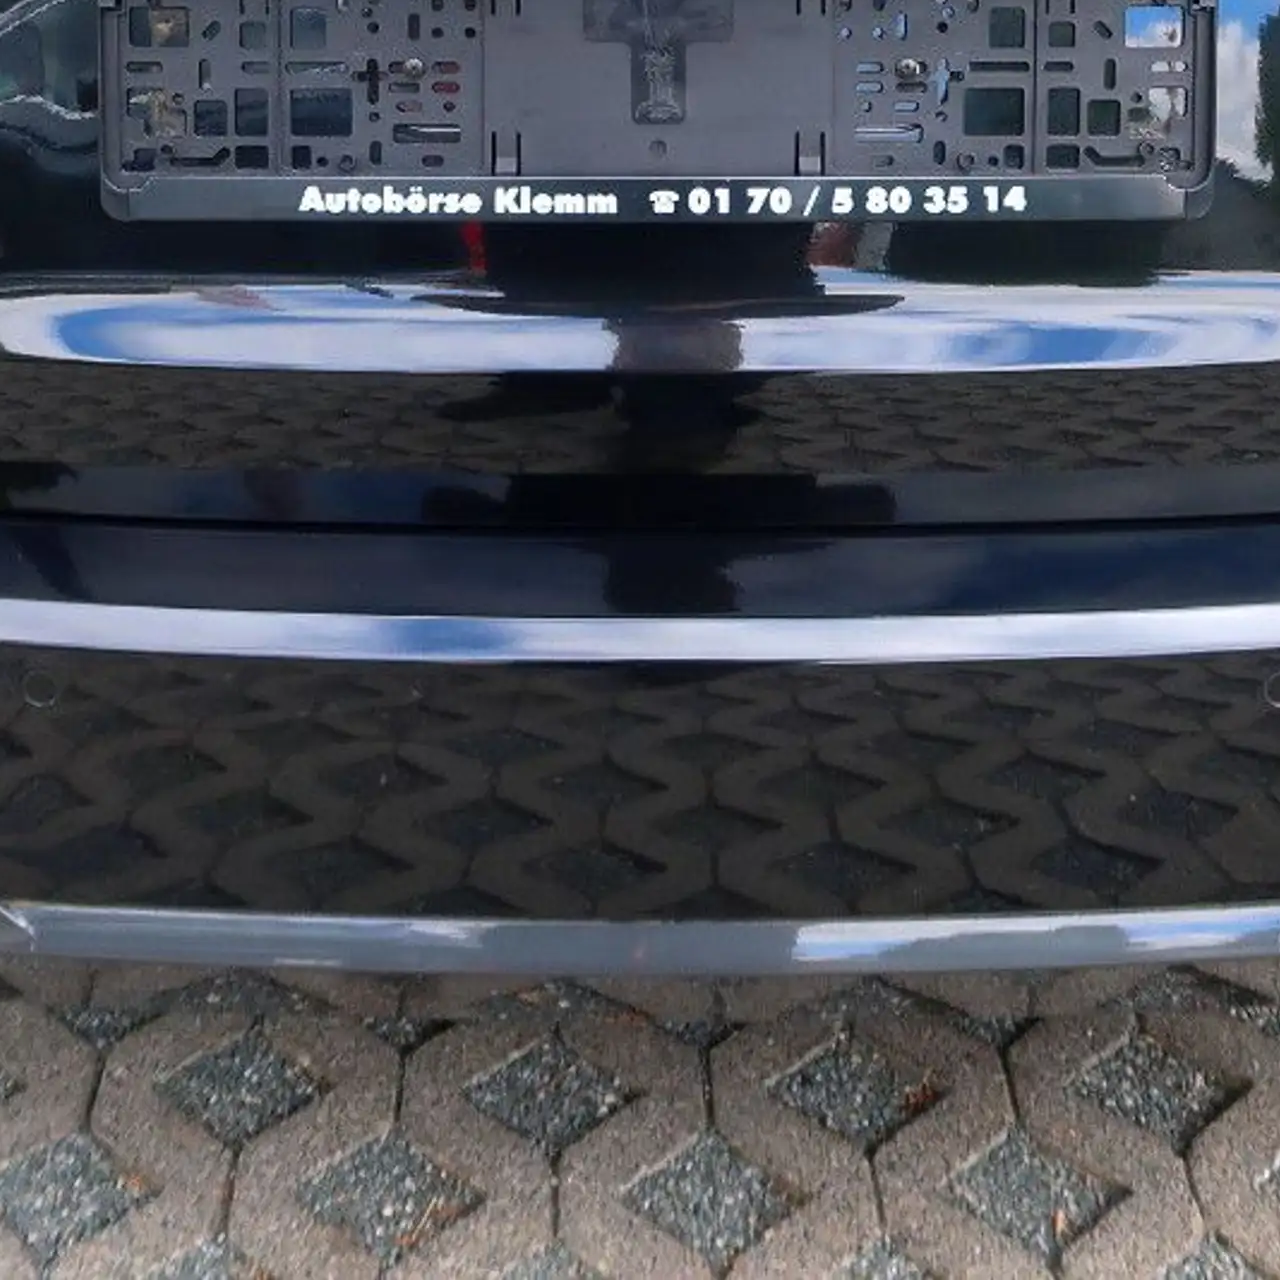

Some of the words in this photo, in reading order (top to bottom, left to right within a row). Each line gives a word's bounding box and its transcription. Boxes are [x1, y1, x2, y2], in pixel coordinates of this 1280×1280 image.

[298, 185, 483, 214] Autobörse
[494, 185, 618, 214] Klemm
[688, 187, 730, 214] 01
[747, 186, 793, 214] 70
[803, 186, 821, 217] /
[831, 187, 854, 214] 5
[865, 186, 912, 214] 80
[923, 186, 969, 214] 35
[983, 185, 1027, 213] 14
